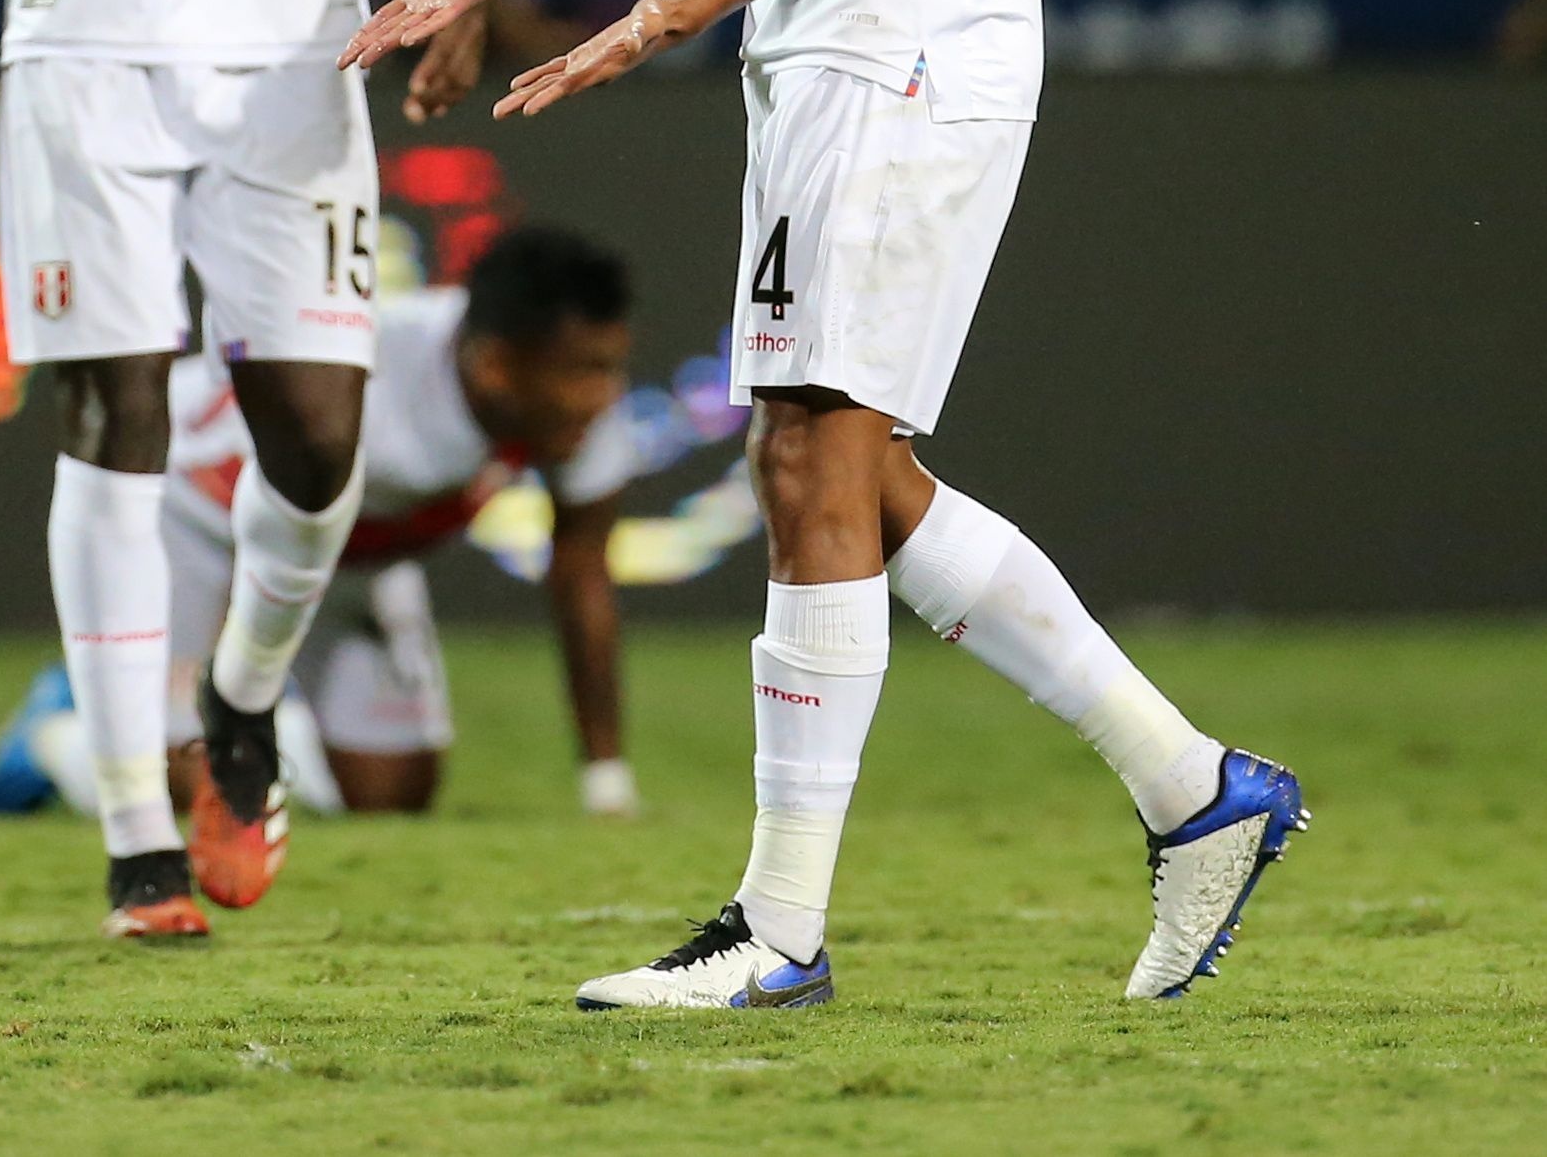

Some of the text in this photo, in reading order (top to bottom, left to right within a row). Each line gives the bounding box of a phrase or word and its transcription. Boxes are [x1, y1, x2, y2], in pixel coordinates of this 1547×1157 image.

[313, 202, 372, 300] 15
[752, 216, 794, 320] 4
[744, 332, 796, 352] athon
